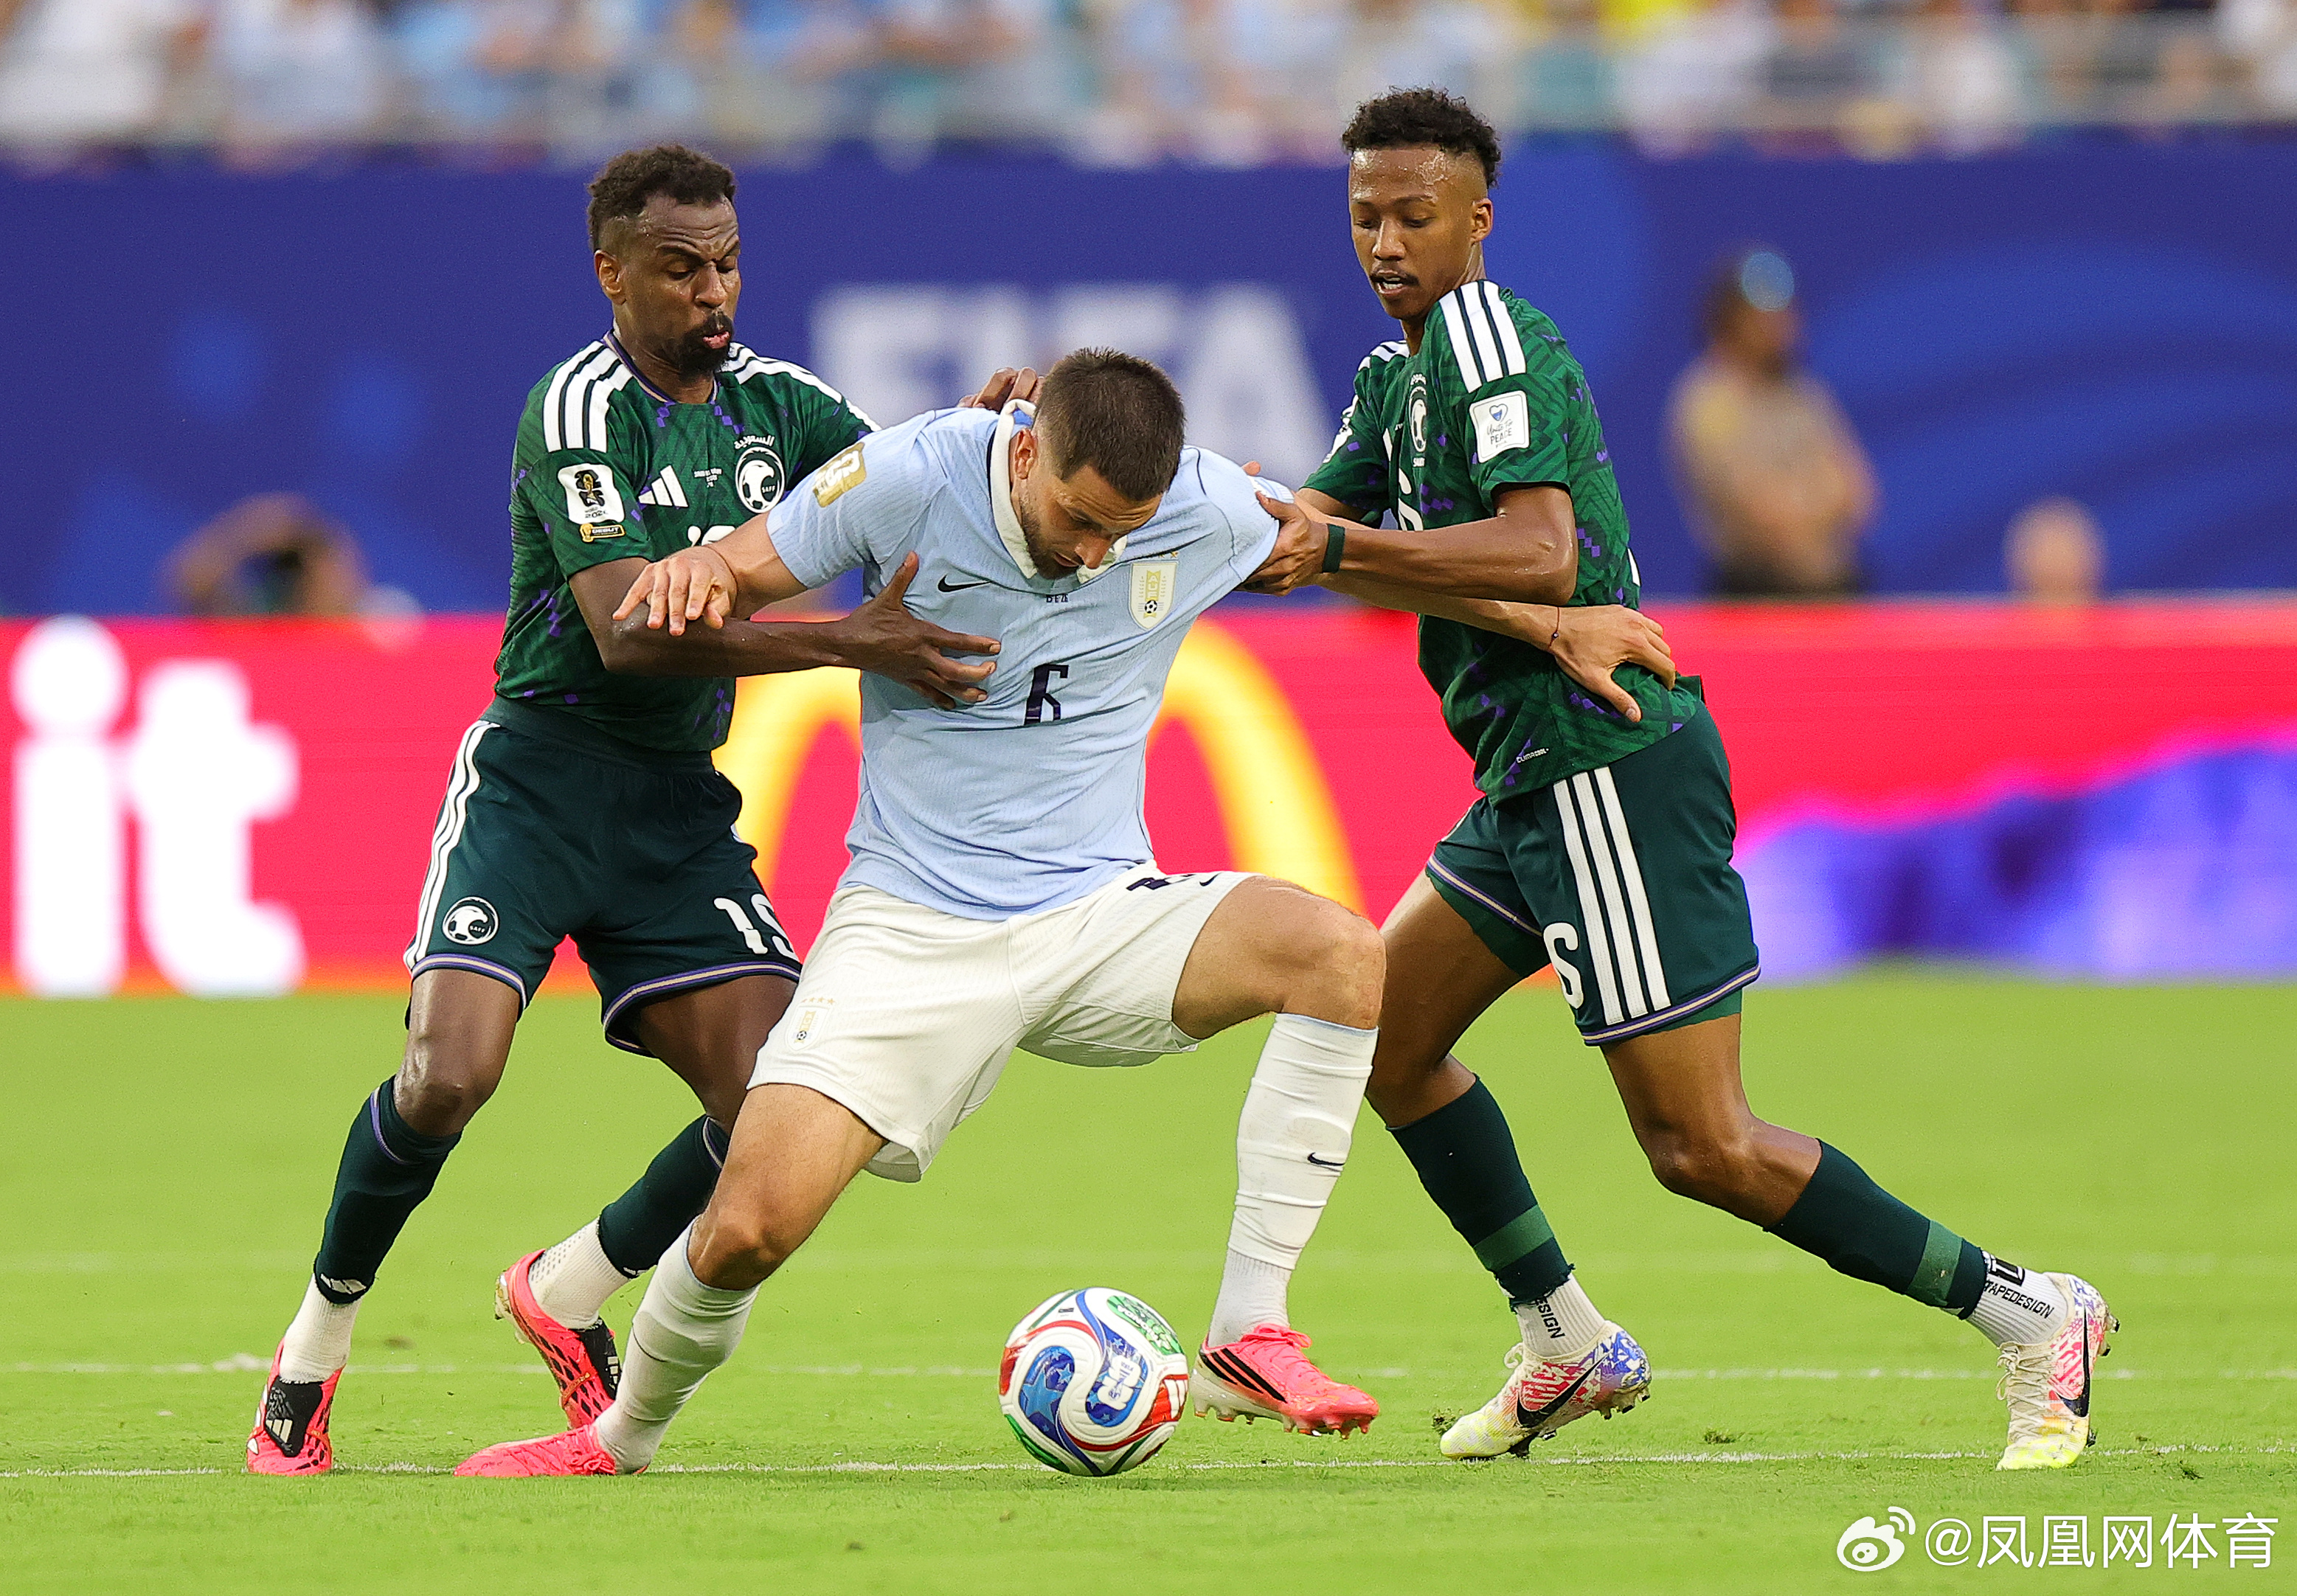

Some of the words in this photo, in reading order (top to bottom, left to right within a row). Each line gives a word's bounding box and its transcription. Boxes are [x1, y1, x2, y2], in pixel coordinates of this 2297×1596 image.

[1490, 428, 1513, 445] PEACE
[761, 485, 776, 493] SAFF
[10, 615, 307, 1000] it
[469, 925, 486, 933] SAFF
[1984, 1280, 2055, 1319] TAPEDESIGN
[1535, 1297, 1566, 1339] ESIGN
